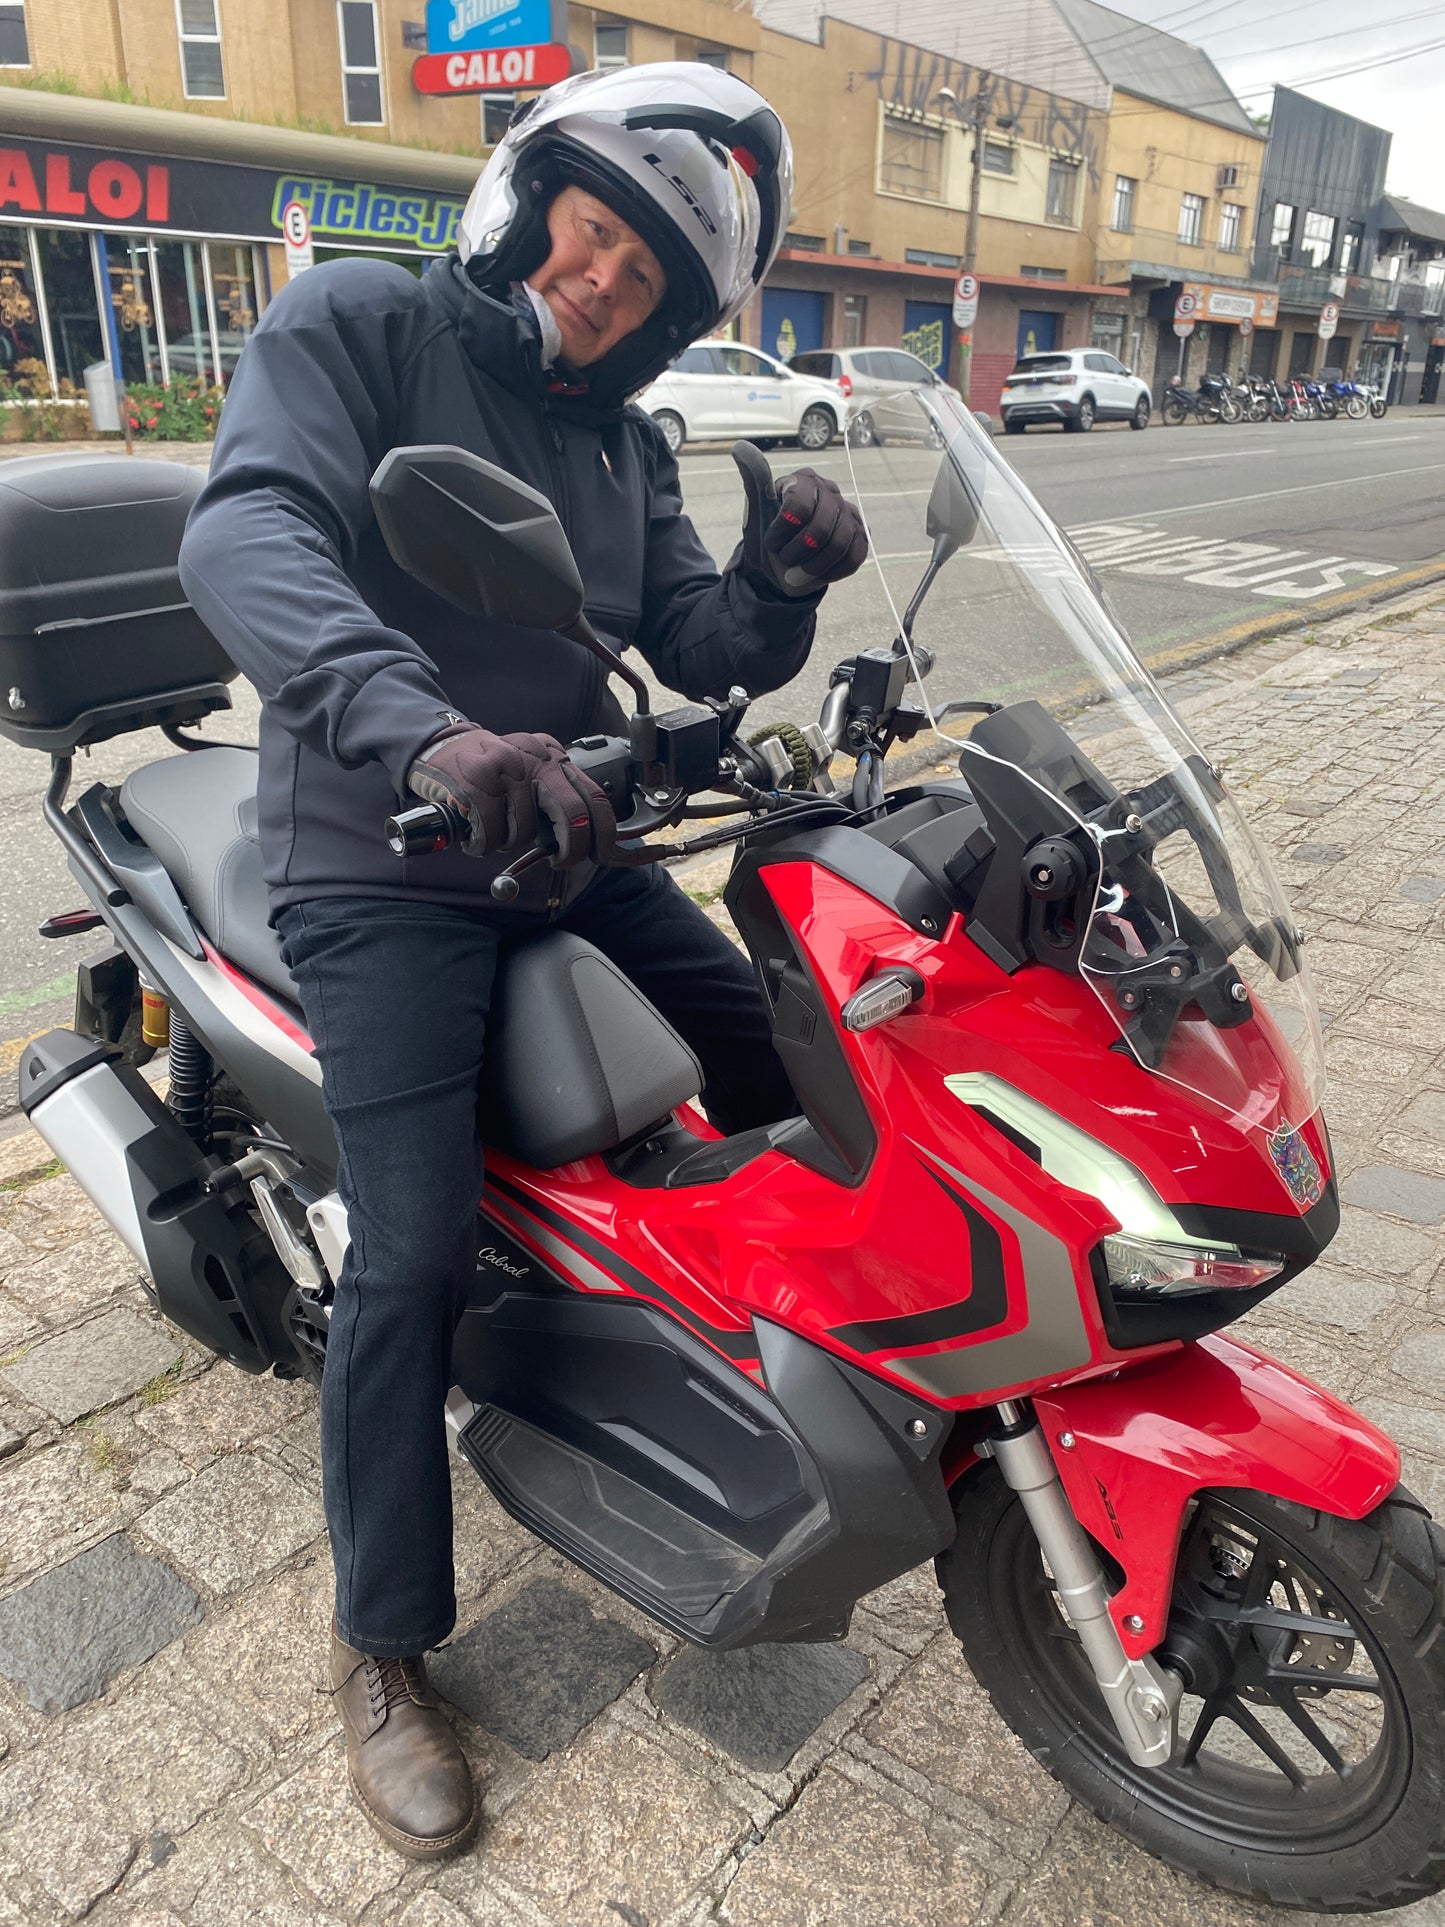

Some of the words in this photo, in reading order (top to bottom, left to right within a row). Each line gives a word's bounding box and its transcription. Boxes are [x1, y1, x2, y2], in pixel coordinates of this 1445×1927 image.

[446, 50, 535, 87] CALOI
[642, 153, 717, 236] LS2
[291, 212, 302, 237] E
[963, 279, 971, 294] E
[1183, 297, 1190, 310] E
[1326, 308, 1333, 319] E
[478, 1247, 530, 1278] Cabral
[1094, 1475, 1125, 1541] ABS
